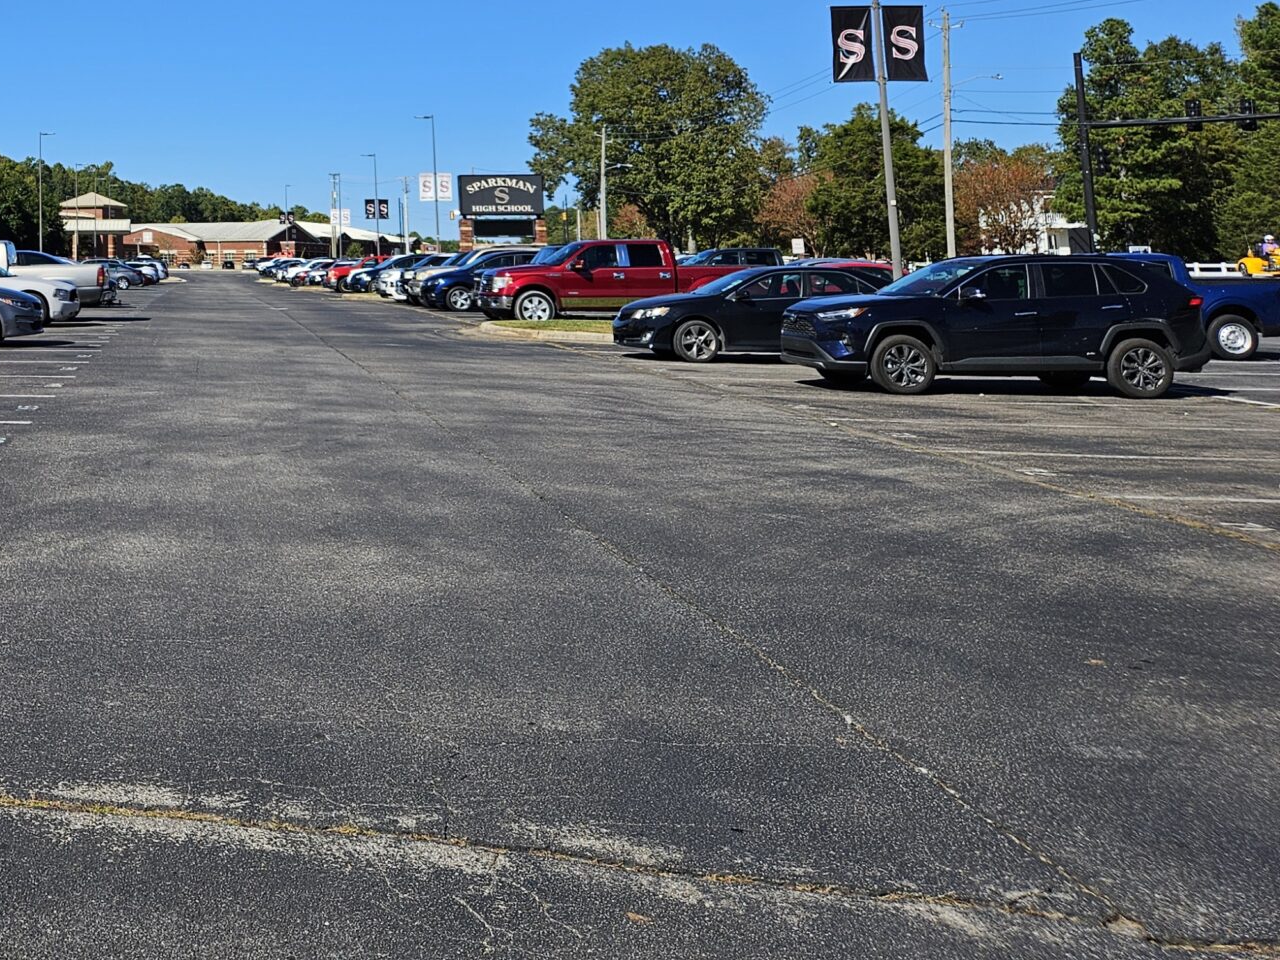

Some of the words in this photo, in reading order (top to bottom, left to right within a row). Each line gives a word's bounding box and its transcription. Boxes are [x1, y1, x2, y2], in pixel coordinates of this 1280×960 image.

[837, 29, 865, 63] S
[890, 25, 918, 60] S
[422, 180, 432, 193] S
[439, 180, 449, 193] S
[465, 177, 537, 194] SPARKMAN
[494, 187, 510, 204] S
[366, 203, 375, 214] S
[380, 203, 388, 214] S
